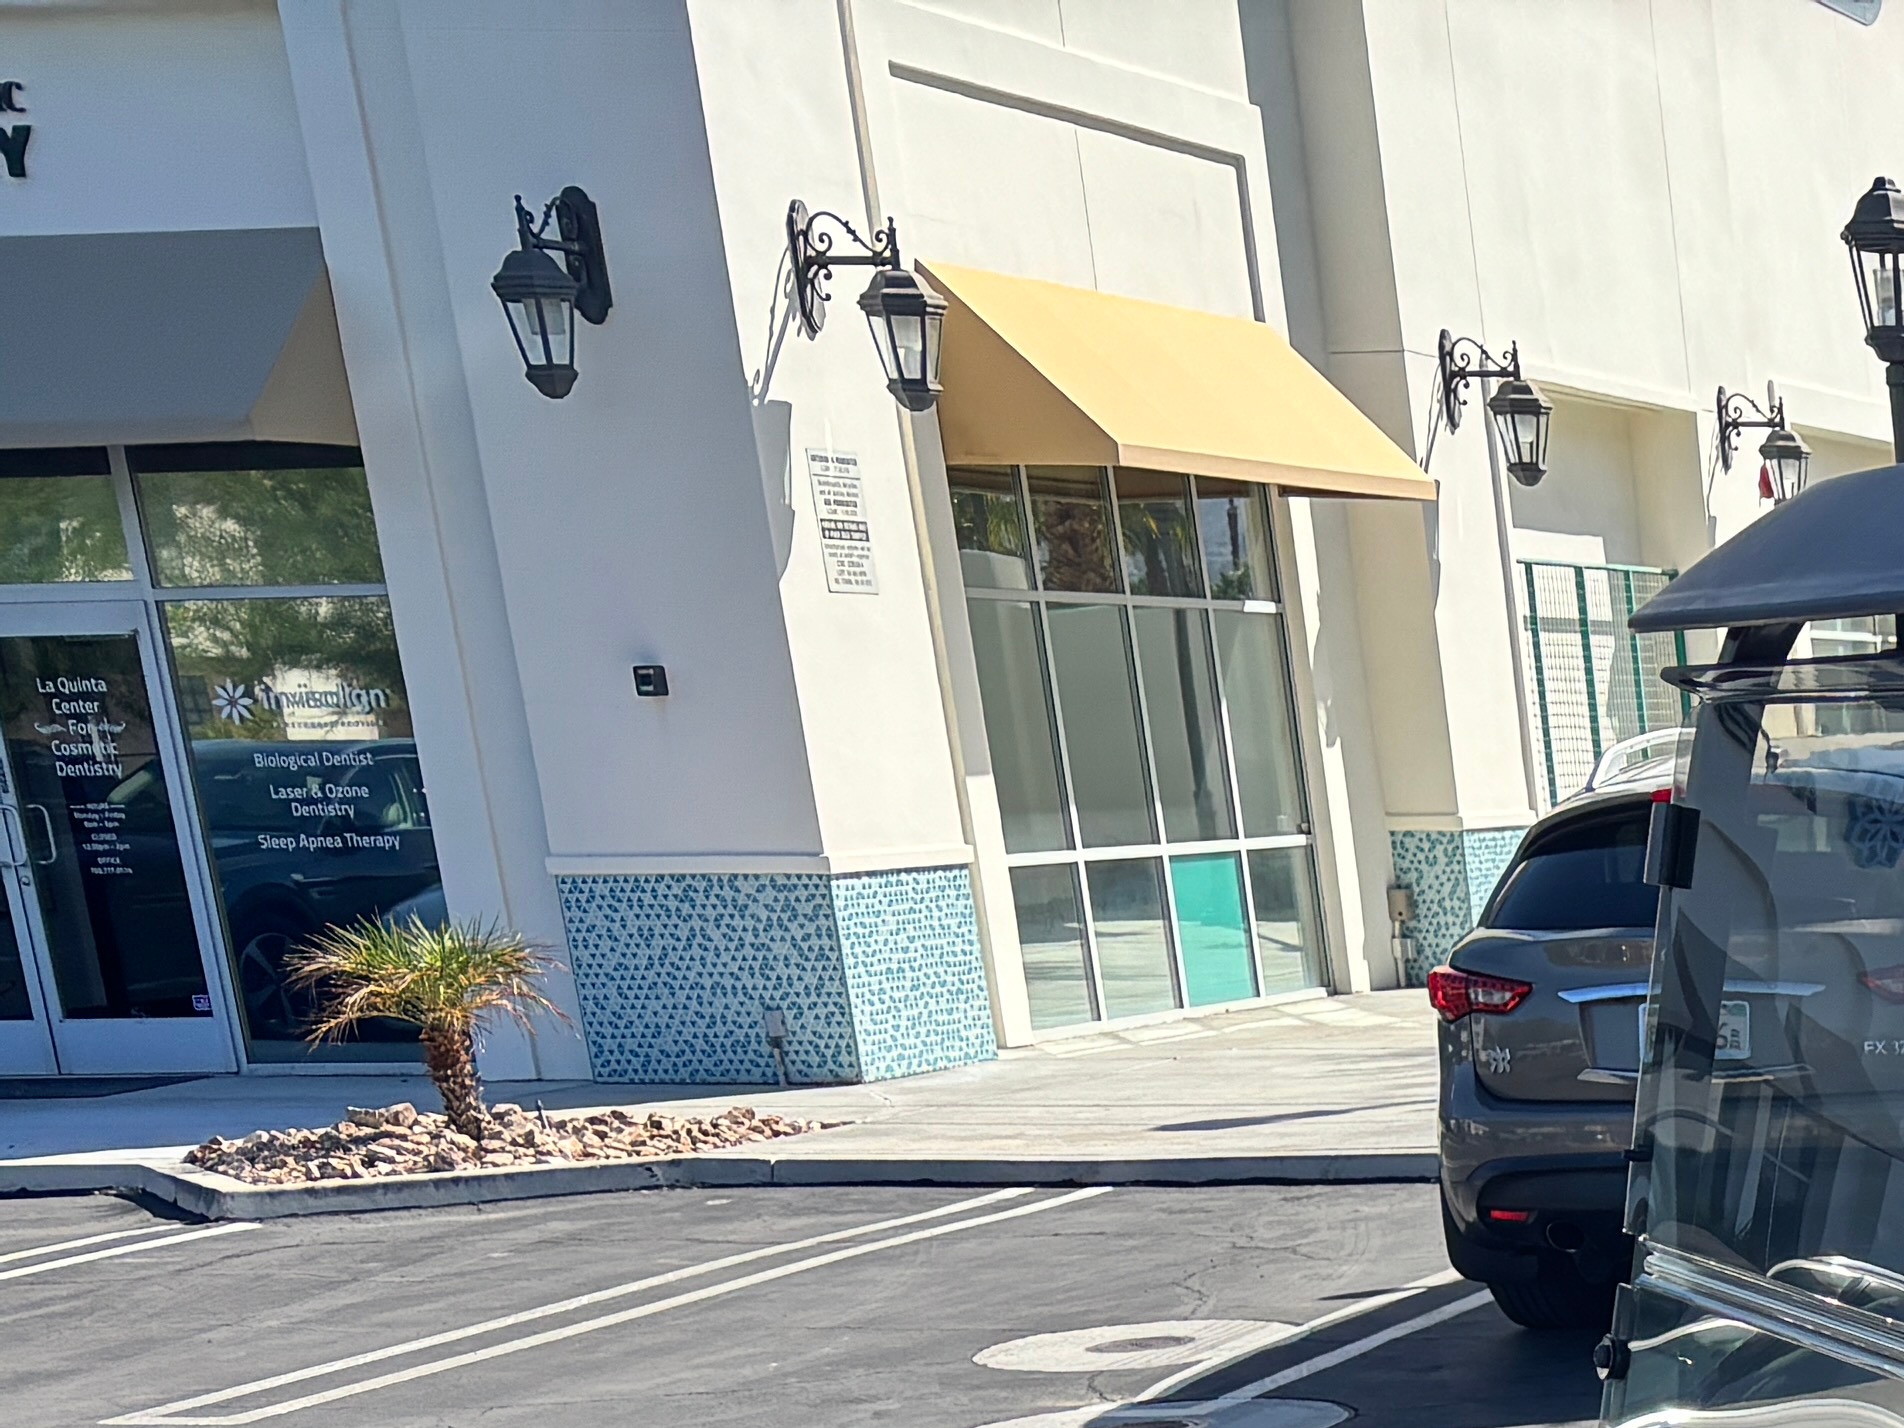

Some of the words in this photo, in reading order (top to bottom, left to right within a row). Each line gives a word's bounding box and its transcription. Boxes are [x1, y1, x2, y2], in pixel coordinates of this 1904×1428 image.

[36, 677, 55, 693] La
[57, 676, 107, 694] Quinta
[52, 698, 100, 714] Center
[253, 751, 320, 770] Biological
[323, 751, 374, 766] Dentist
[55, 761, 122, 779] Dentistry
[269, 784, 308, 799] Laser
[311, 784, 323, 798] &
[325, 783, 370, 798] Ozone
[291, 802, 355, 820] Dentistry
[257, 834, 297, 851] Sleep
[299, 833, 343, 851] Apnea
[343, 832, 400, 851] Therapy
